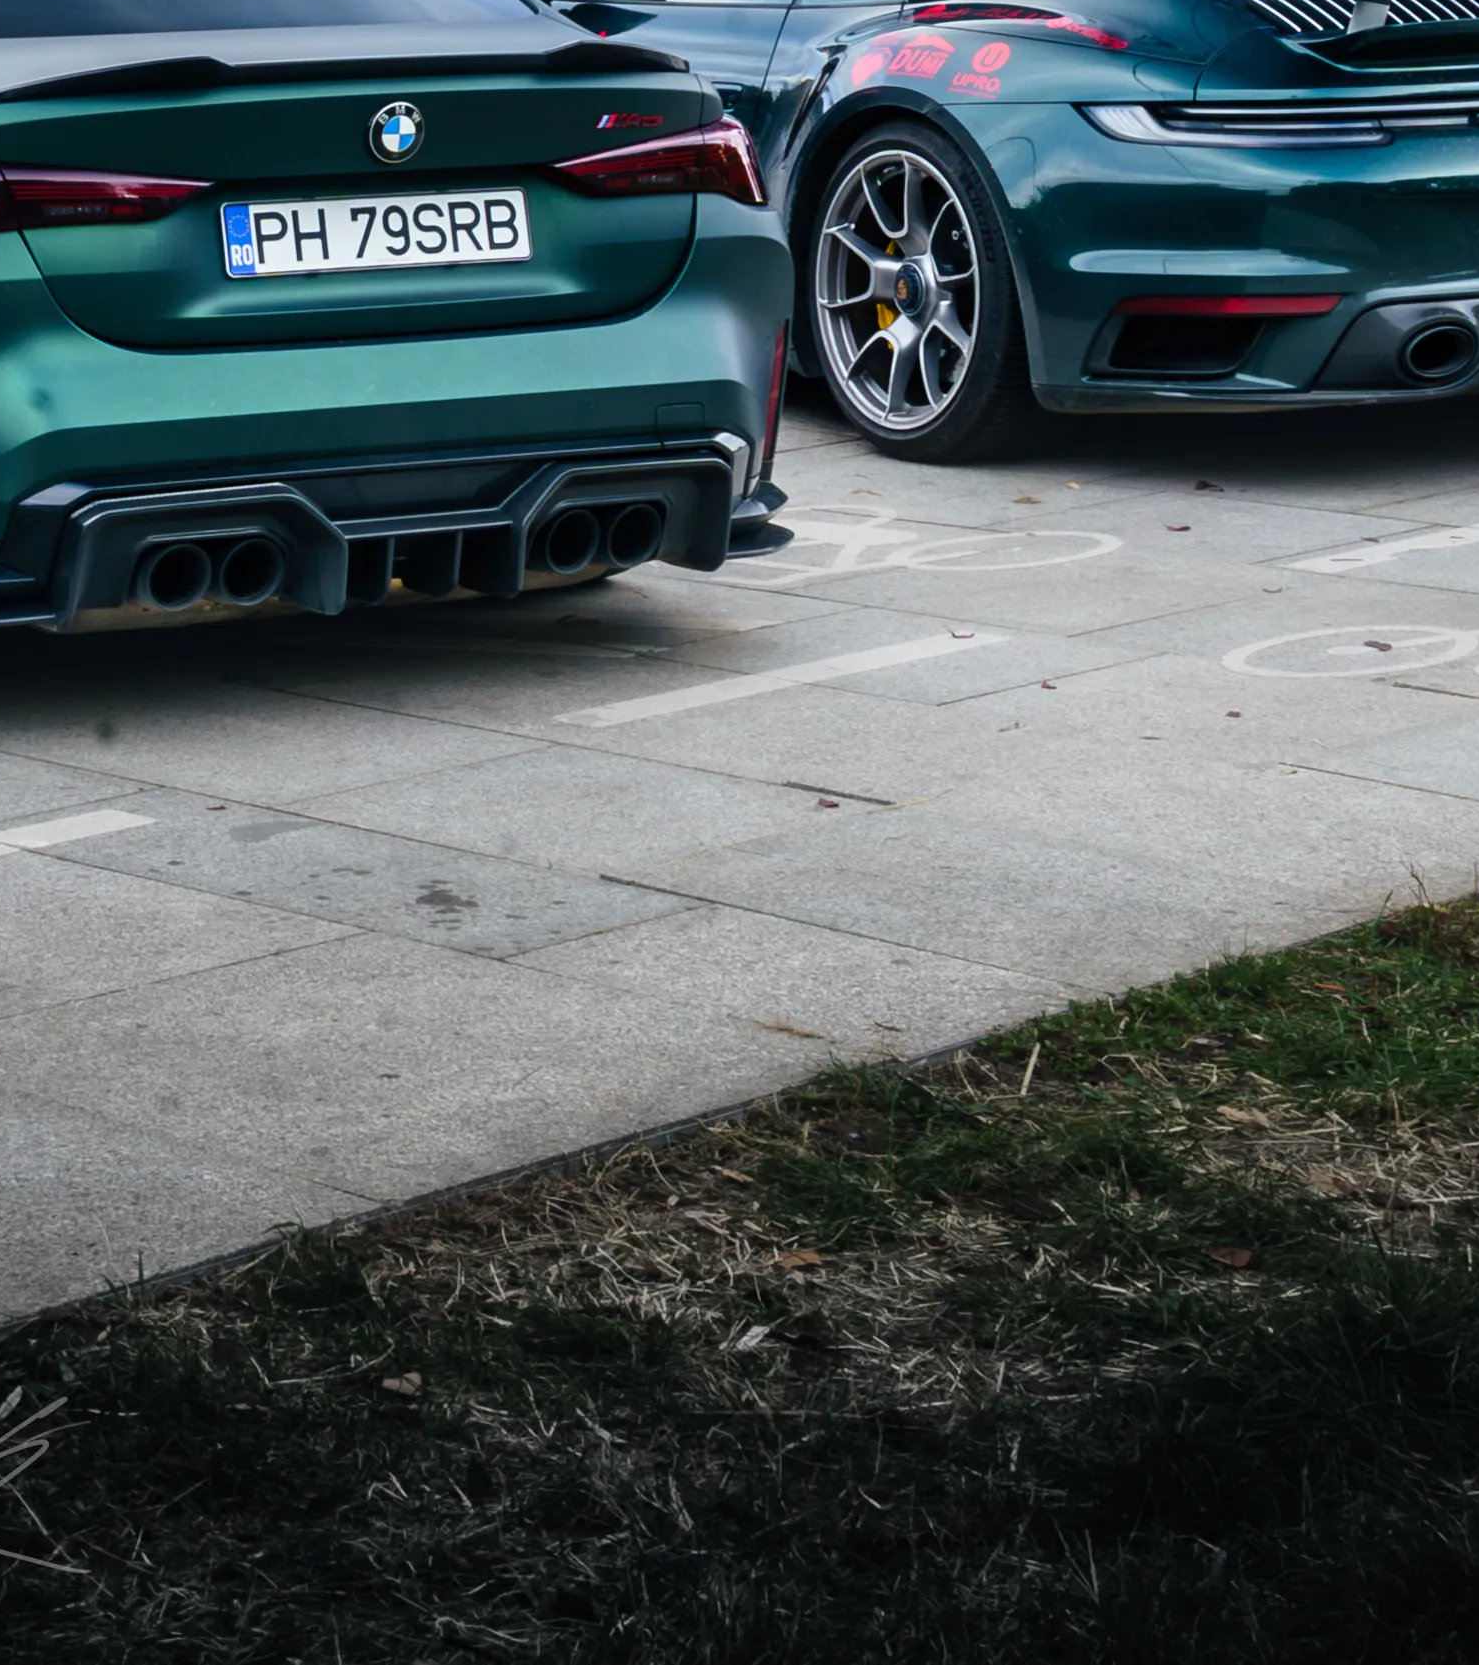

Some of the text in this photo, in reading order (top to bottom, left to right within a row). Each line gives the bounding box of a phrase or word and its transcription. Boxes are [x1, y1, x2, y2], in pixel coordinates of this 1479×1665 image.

[378, 105, 421, 125] BMW
[230, 198, 519, 267] RO PH 79SRB
